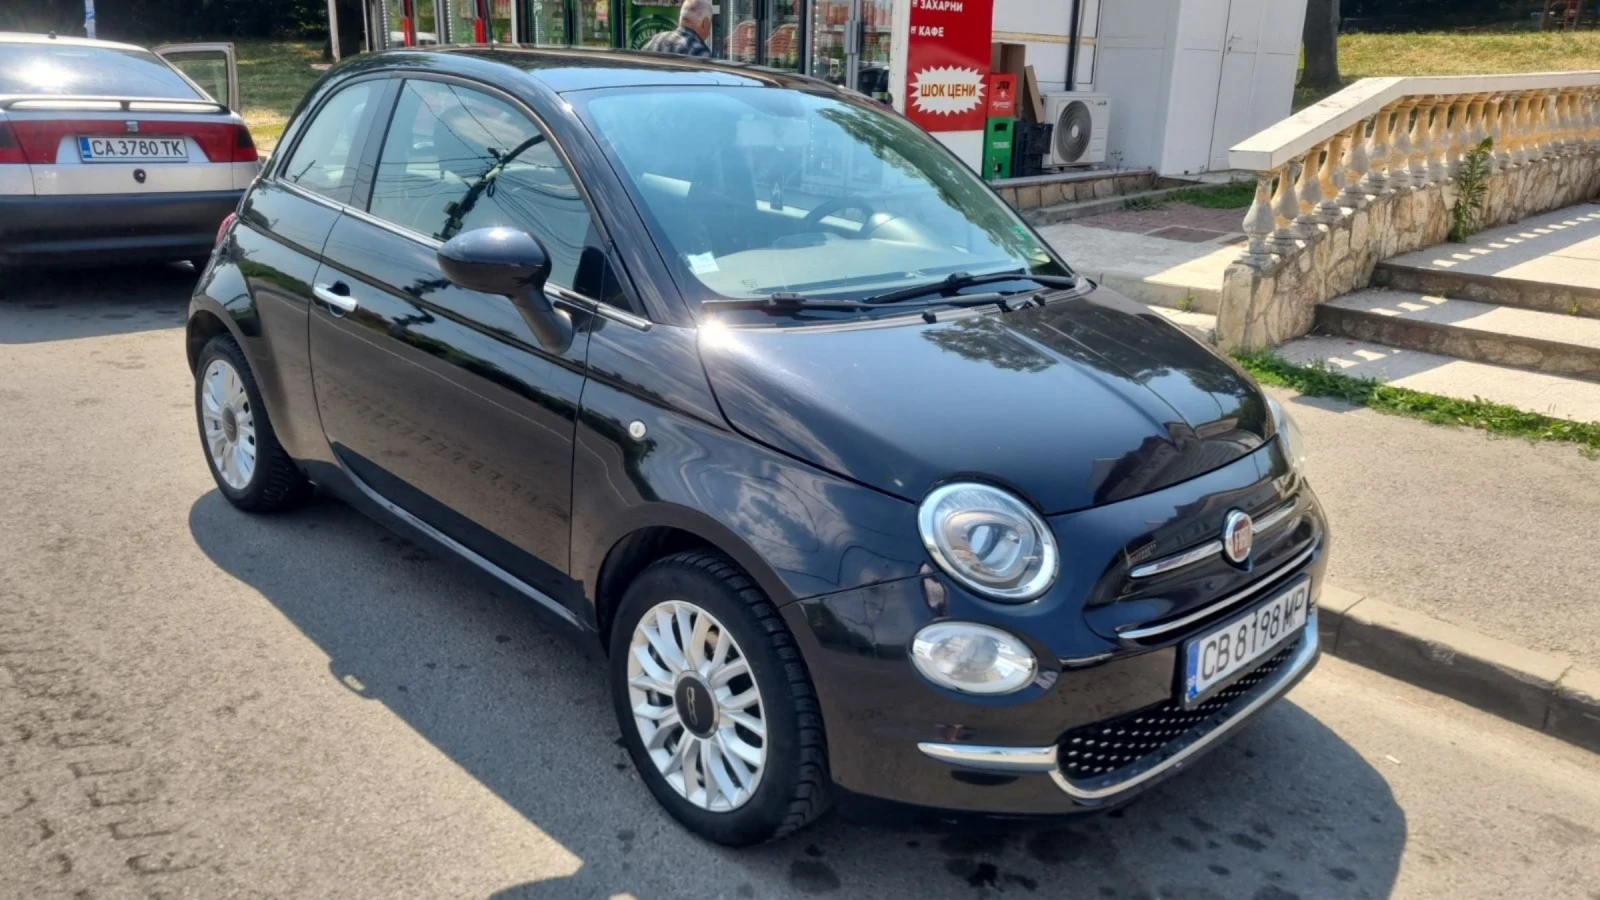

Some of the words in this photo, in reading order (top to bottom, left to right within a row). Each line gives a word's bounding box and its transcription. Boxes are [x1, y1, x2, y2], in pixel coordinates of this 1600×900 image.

[920, 0, 963, 12] ЗАХАРНИ
[918, 26, 944, 37] КАФЕ
[921, 84, 945, 97] ШОК
[948, 84, 976, 99] ЦЕНИ
[92, 140, 116, 156] CA
[118, 141, 158, 155] 3780
[160, 141, 183, 156] TK
[1202, 633, 1231, 681] CB
[1234, 604, 1281, 662] 8198
